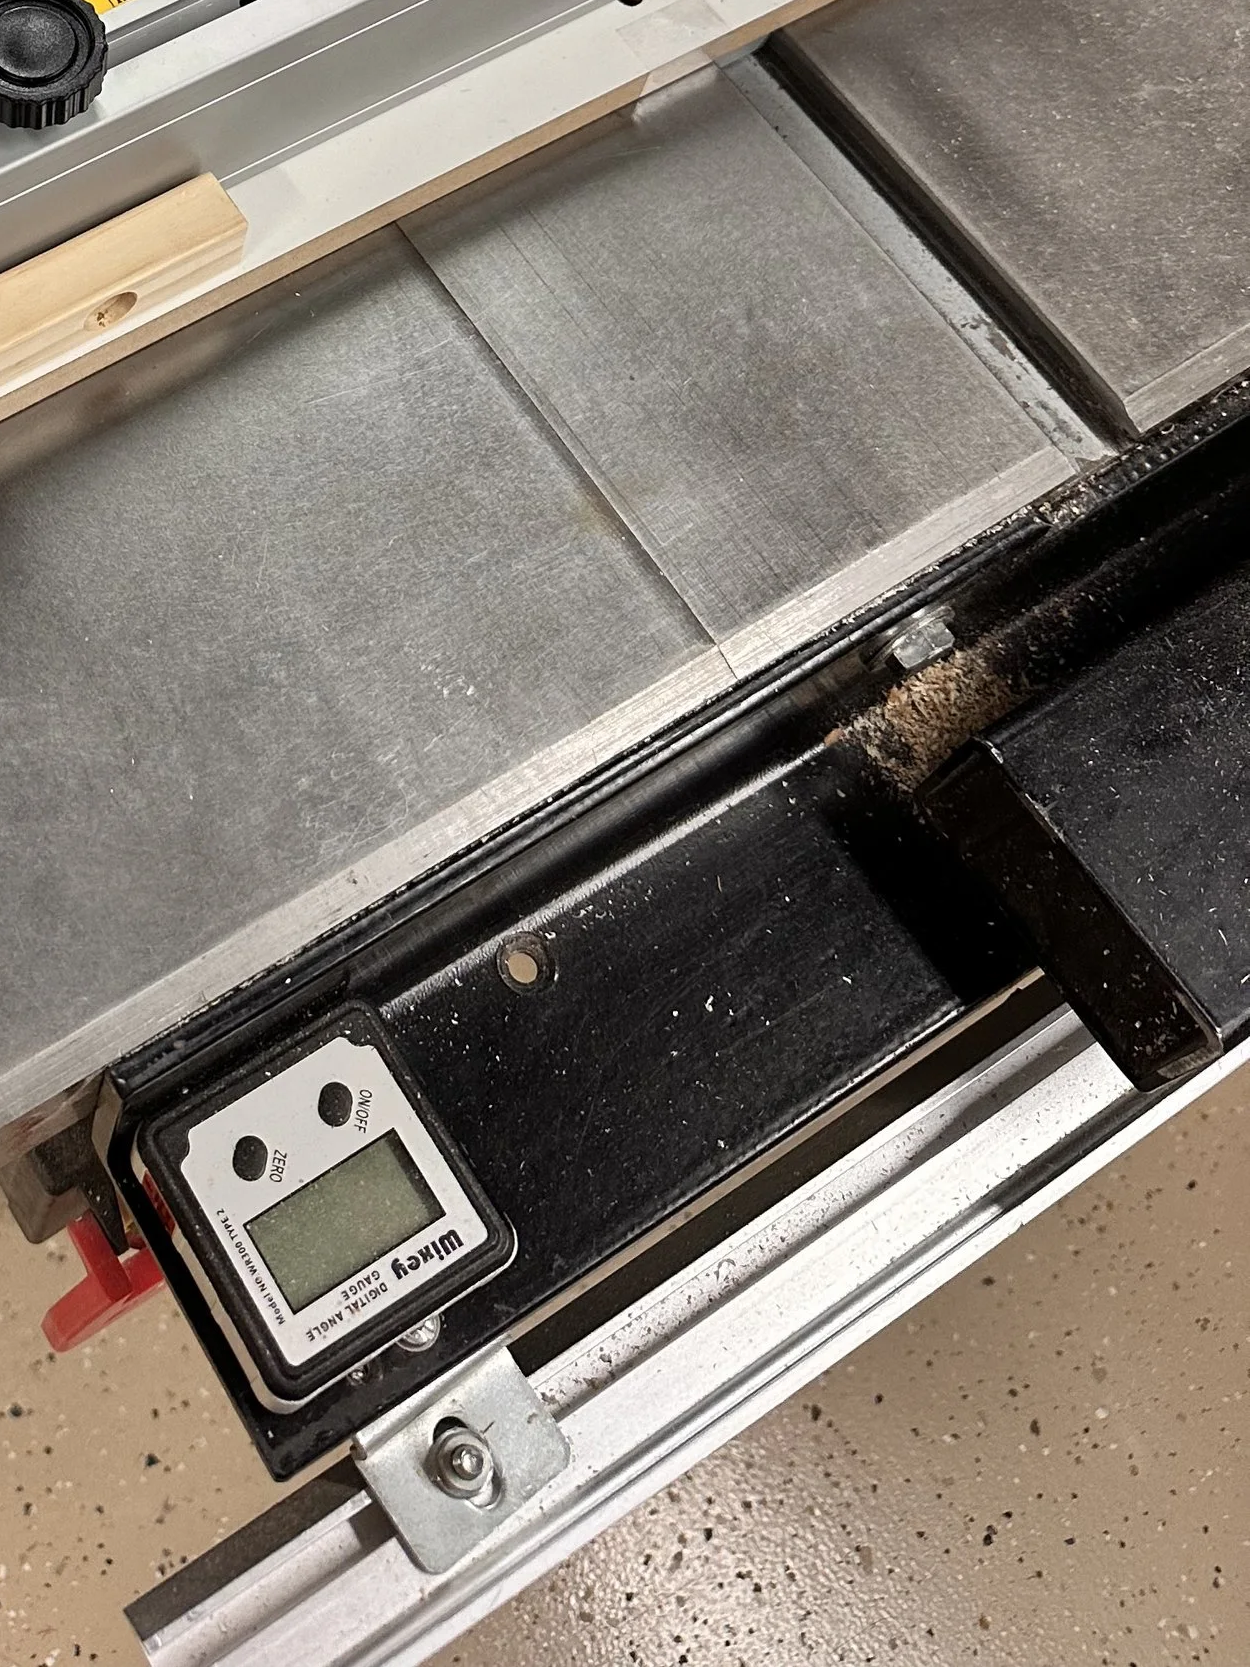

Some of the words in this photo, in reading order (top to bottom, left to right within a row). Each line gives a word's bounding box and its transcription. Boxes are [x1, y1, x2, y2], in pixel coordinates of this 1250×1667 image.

[354, 1089, 373, 1134] ON/OFF
[269, 1149, 287, 1183] ZERO
[216, 1208, 225, 1216] 2
[220, 1216, 238, 1241] TYPE
[390, 1229, 465, 1280] Wixey
[341, 1270, 381, 1300] GAUGE
[344, 1282, 388, 1315] DIGITAL
[263, 1293, 286, 1325] Model
[305, 1310, 344, 1342] ANGLE
